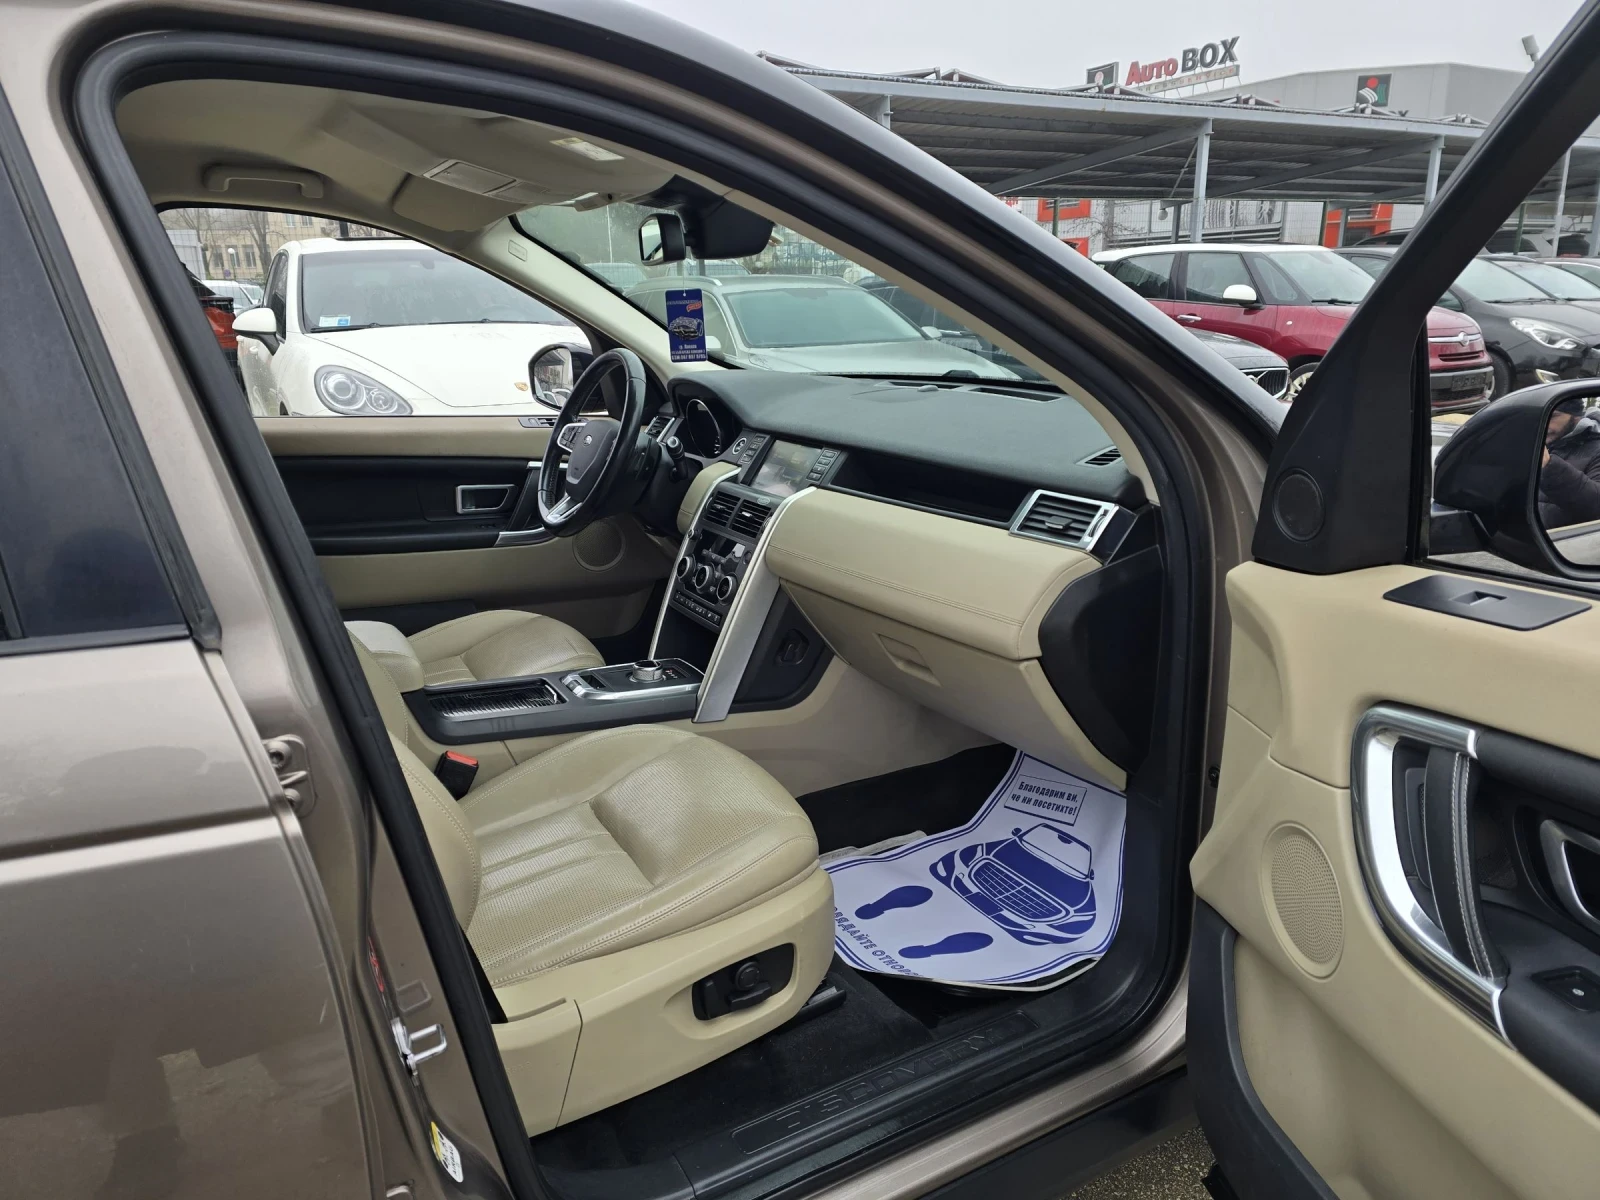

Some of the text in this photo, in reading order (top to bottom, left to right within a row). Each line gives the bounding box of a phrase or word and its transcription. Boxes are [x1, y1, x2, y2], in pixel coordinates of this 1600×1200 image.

[1125, 36, 1240, 86] AUTO BOX
[1018, 781, 1078, 803] Благодарим ви,
[1011, 793, 1078, 816] че ни посетихте!
